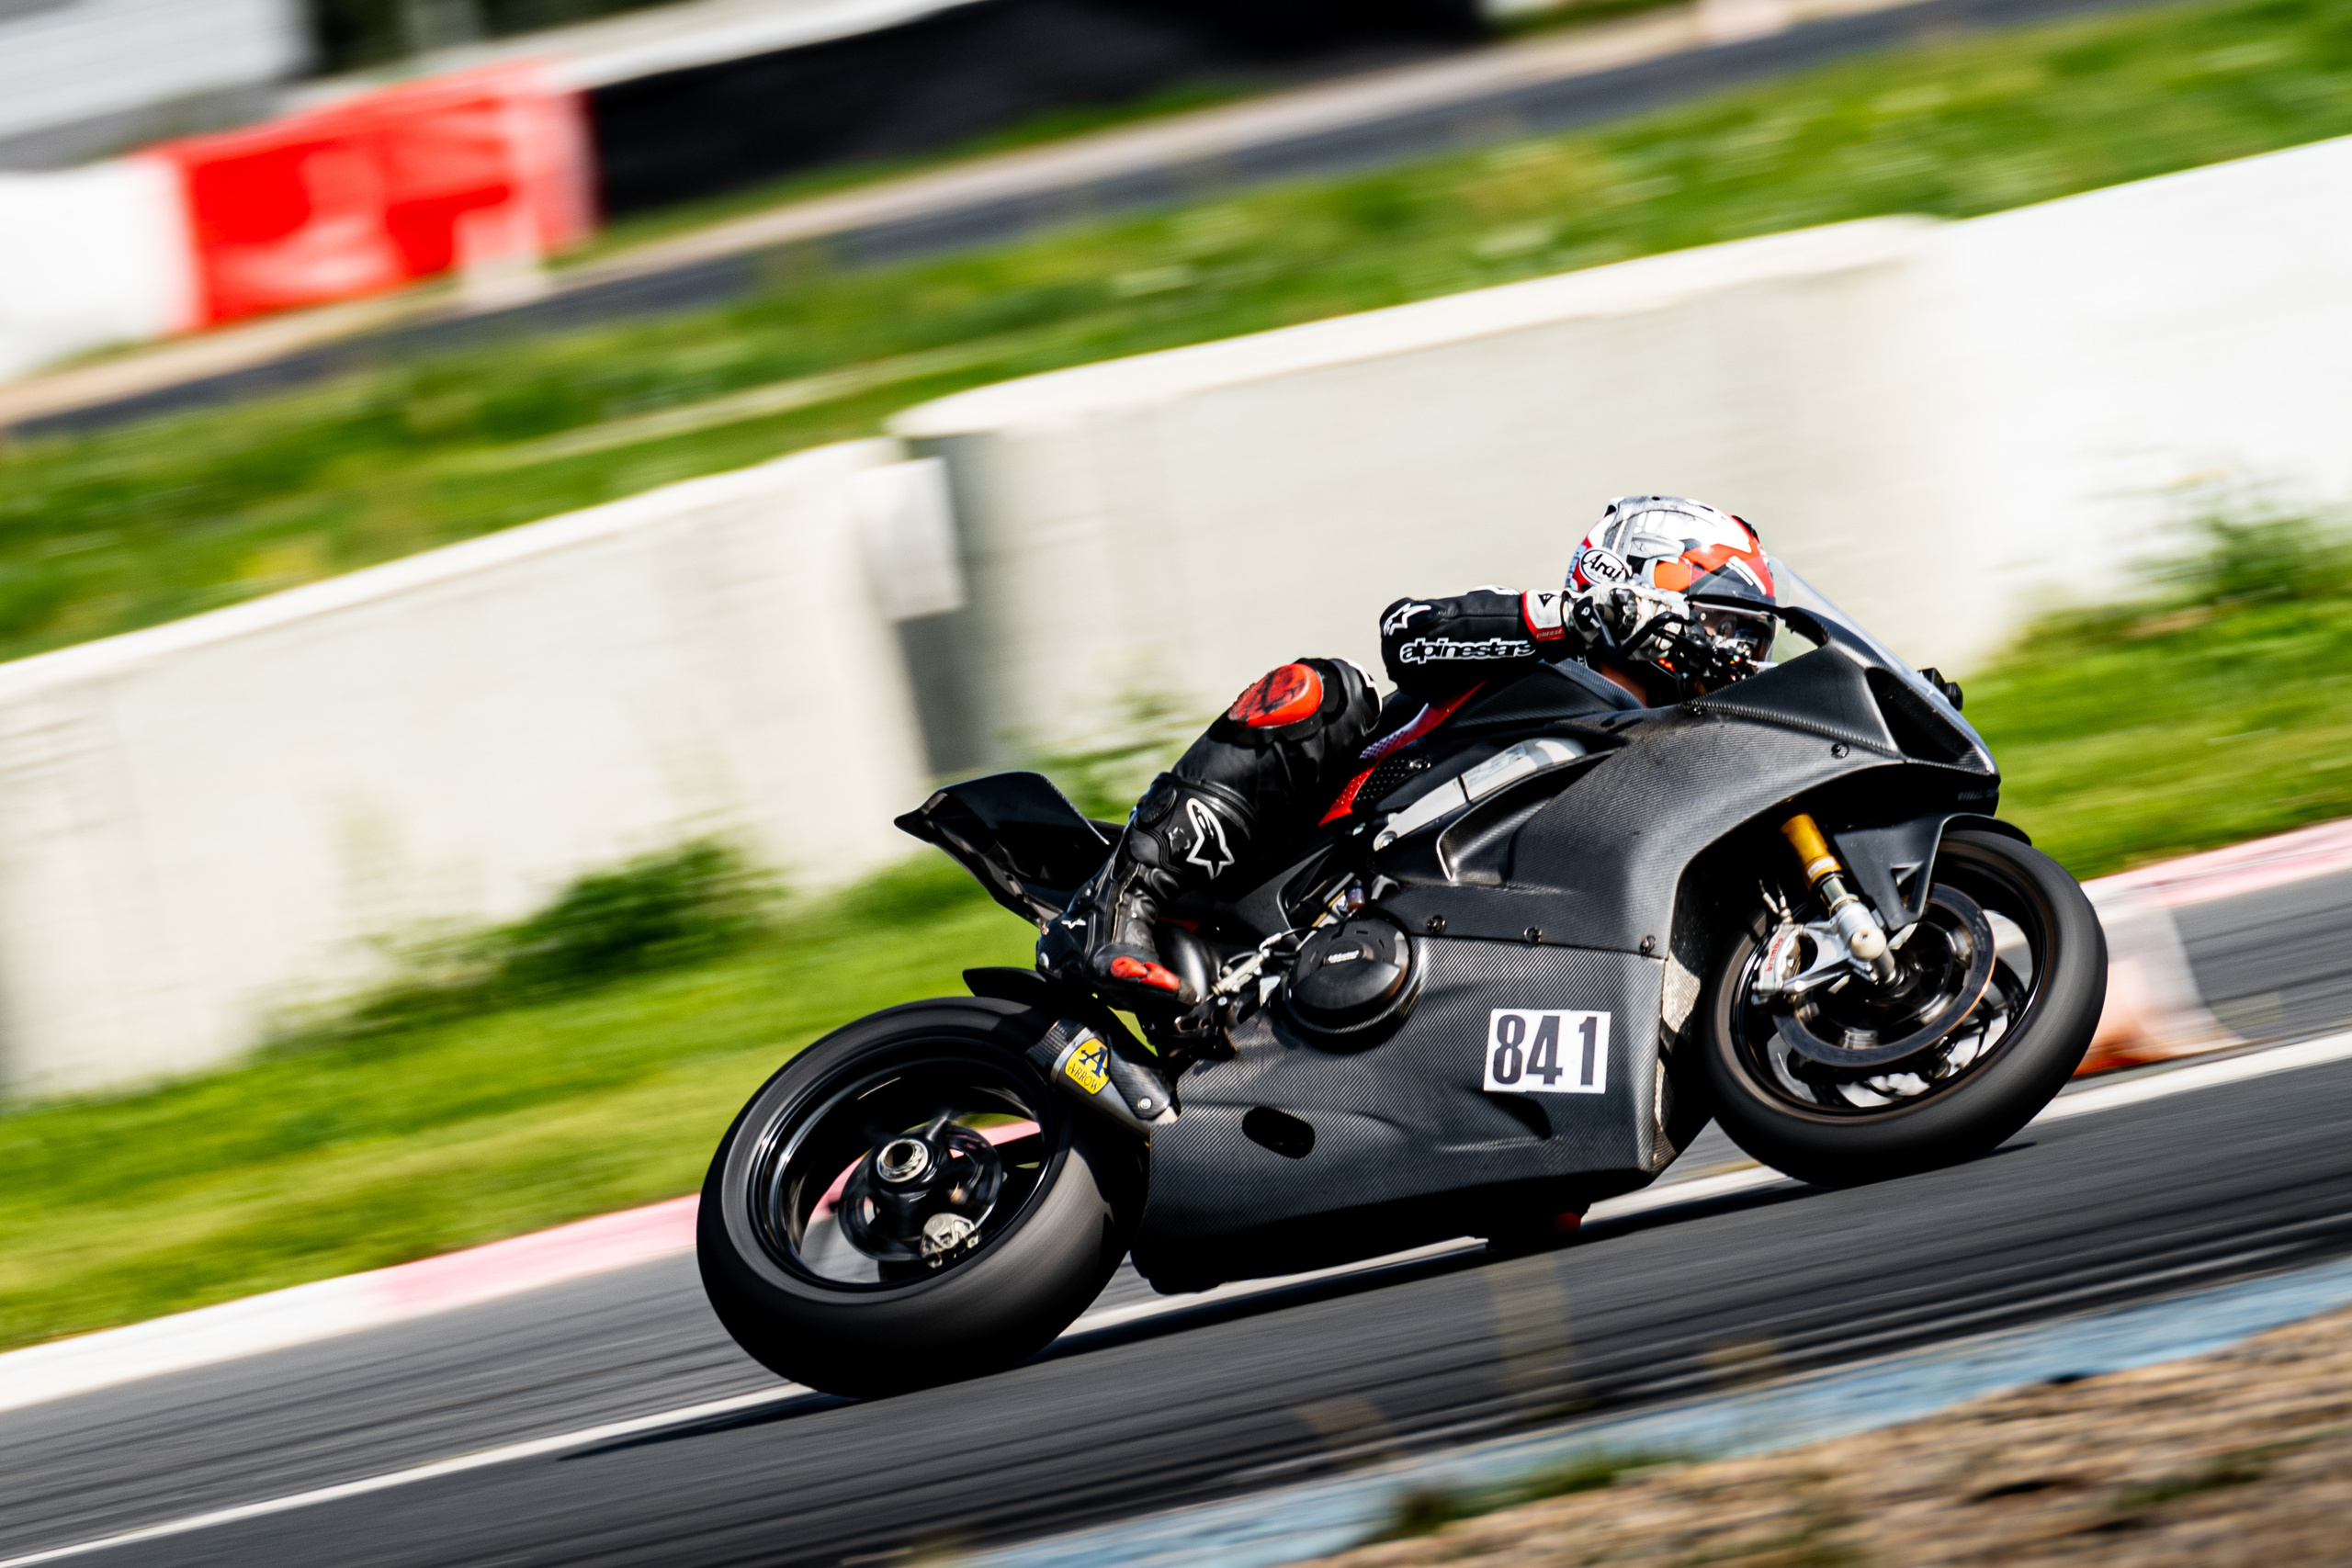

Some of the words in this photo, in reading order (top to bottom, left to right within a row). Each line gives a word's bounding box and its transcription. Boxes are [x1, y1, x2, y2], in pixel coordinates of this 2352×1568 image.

[1582, 554, 1625, 581] Arai
[1400, 637, 1535, 664] alpinestars
[1492, 1014, 1598, 1086] 841
[1067, 1064, 1099, 1091] ARROW
